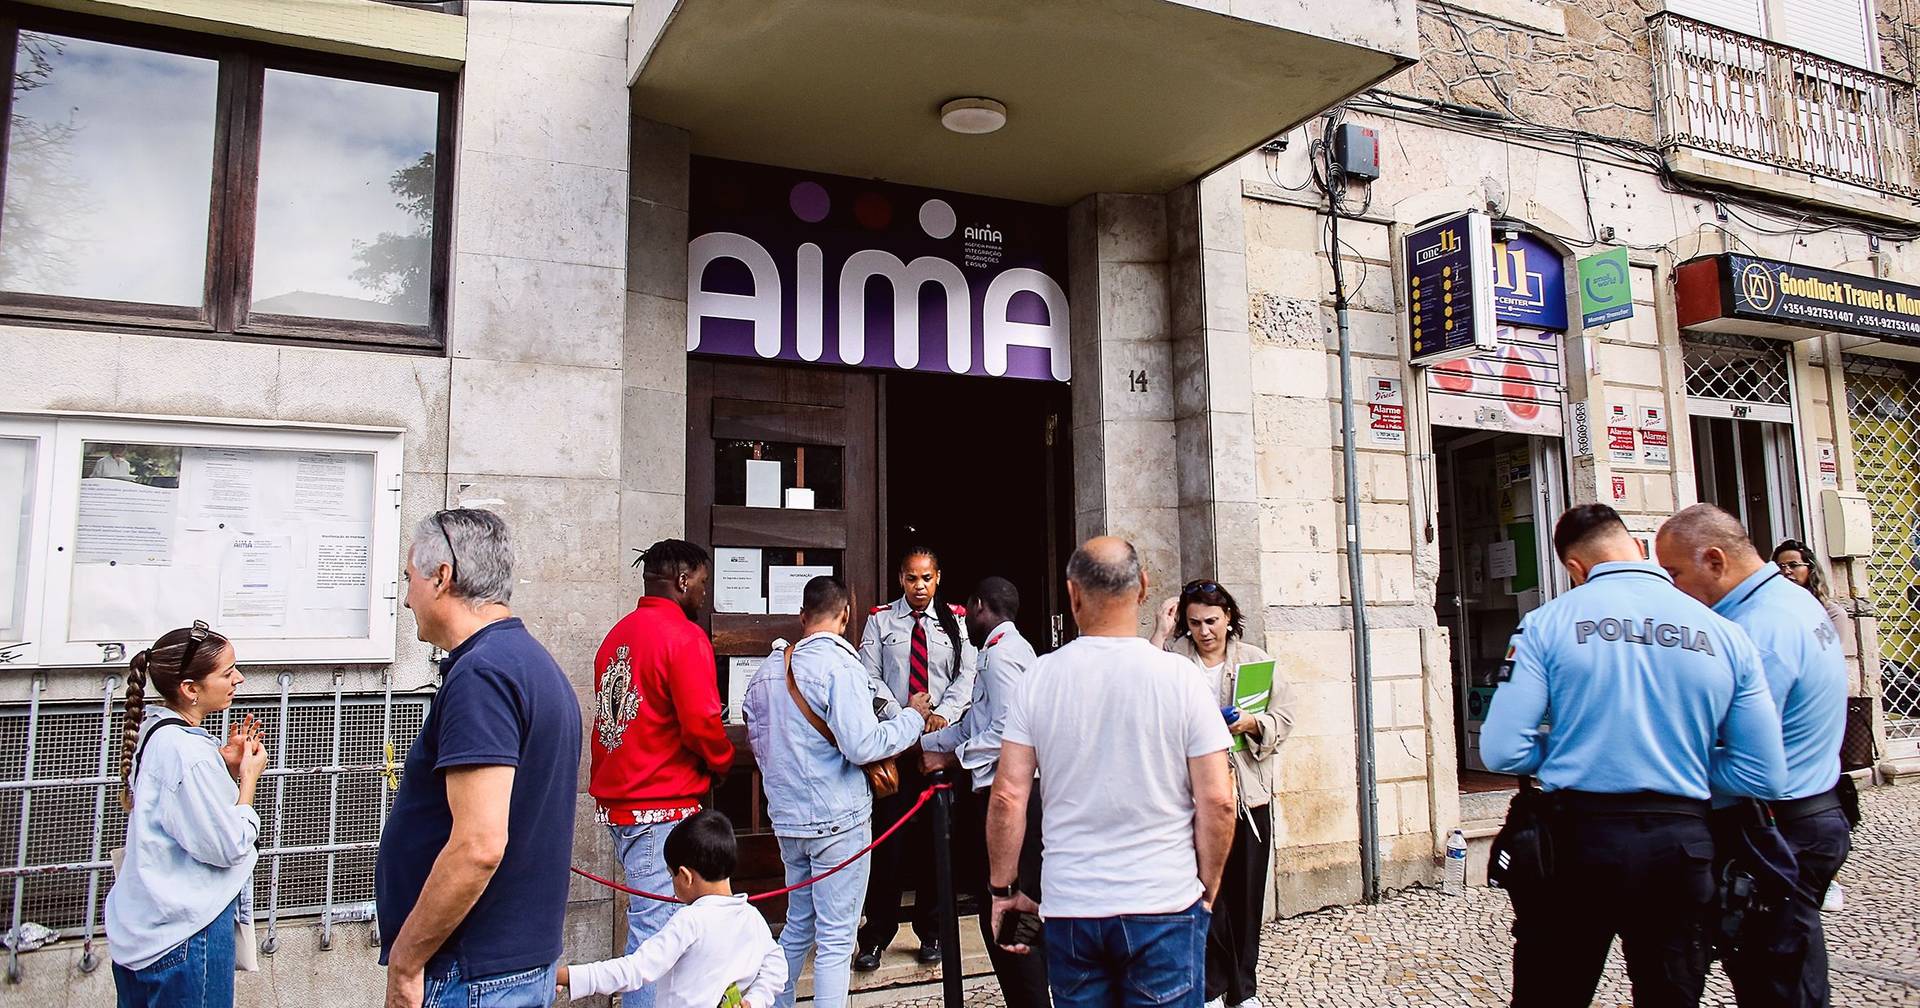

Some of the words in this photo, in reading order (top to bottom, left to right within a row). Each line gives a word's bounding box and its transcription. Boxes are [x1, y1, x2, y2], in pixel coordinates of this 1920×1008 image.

[964, 225, 1002, 243] AIMA
[1422, 247, 1440, 260] one
[1780, 271, 1844, 303] Goodluck
[1843, 283, 1885, 310] Travel
[1885, 294, 1896, 312] &
[686, 231, 1072, 382] AIMA
[1499, 296, 1529, 307] CENTER
[1587, 313, 1606, 324] Money
[1606, 308, 1629, 319] Transfer
[1783, 303, 1854, 323] +351-927531407
[1128, 369, 1148, 392] 14
[1373, 405, 1402, 414] Alarme
[1609, 427, 1632, 436] Alarme
[1643, 431, 1666, 440] Alarme
[1576, 617, 1716, 656] POLÍCIA
